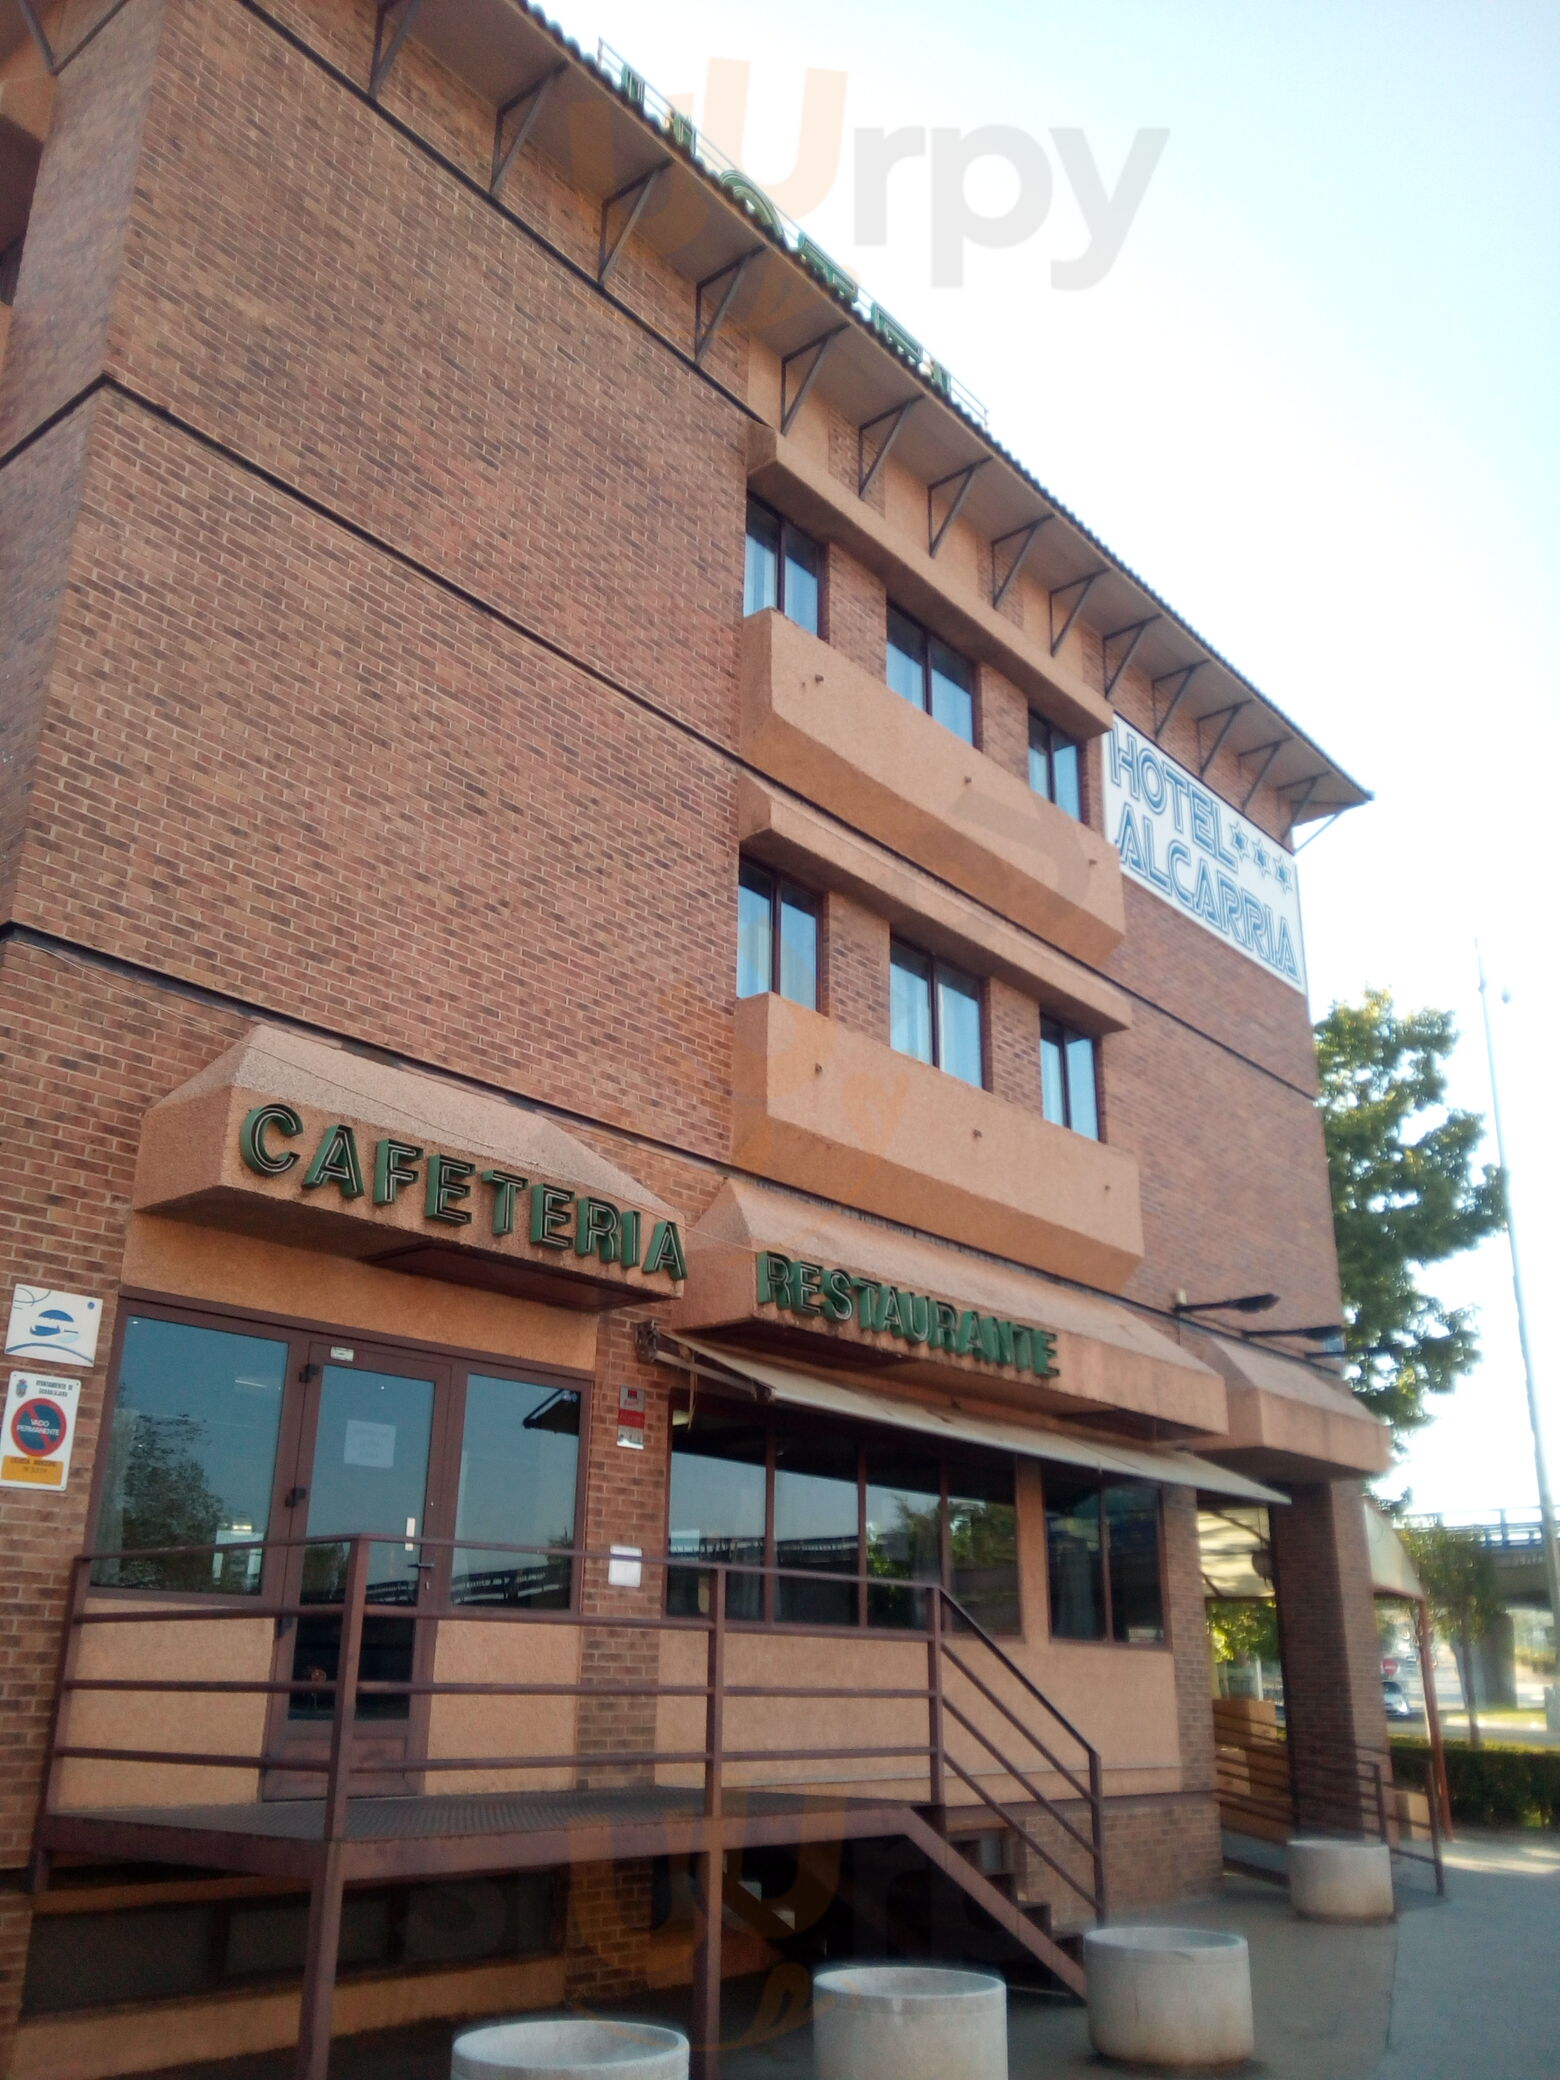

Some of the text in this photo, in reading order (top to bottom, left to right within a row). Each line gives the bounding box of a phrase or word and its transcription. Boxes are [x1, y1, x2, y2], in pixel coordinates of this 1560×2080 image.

[1108, 721, 1239, 875] HOTEL
[1115, 801, 1303, 986] ALCARRIA
[239, 1102, 688, 1281] CAFETERIA
[756, 1249, 1061, 1379] RESTAURANTE
[16, 1424, 60, 1436] PERMANENTE
[30, 1418, 50, 1427] VADO
